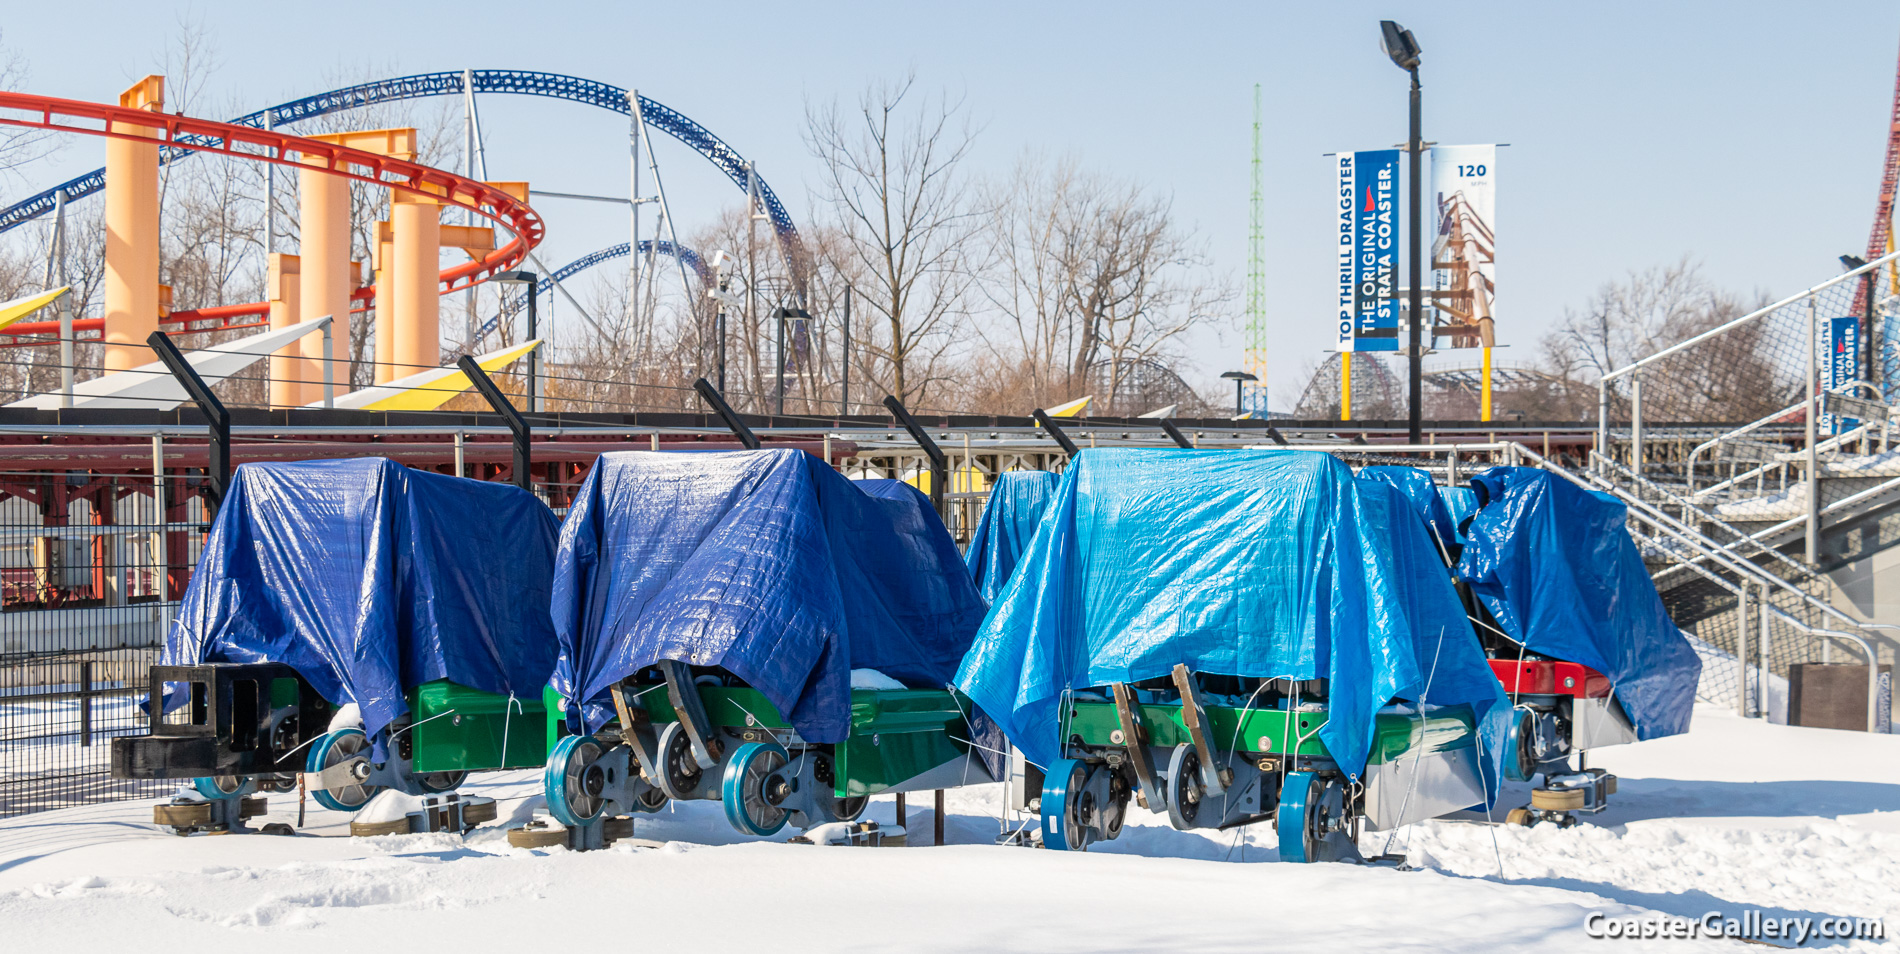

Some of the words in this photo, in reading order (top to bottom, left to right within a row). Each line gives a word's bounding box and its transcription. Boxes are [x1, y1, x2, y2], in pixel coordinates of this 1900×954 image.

[1457, 164, 1487, 177] 120
[1340, 157, 1351, 246] DRAGSTER
[1377, 163, 1392, 250] COASTER.
[1340, 249, 1351, 306] THRILL
[1362, 213, 1376, 296] ORIGINAL
[1377, 254, 1392, 318] STRATA
[1340, 310, 1351, 343] TOP
[1362, 300, 1376, 334] THE
